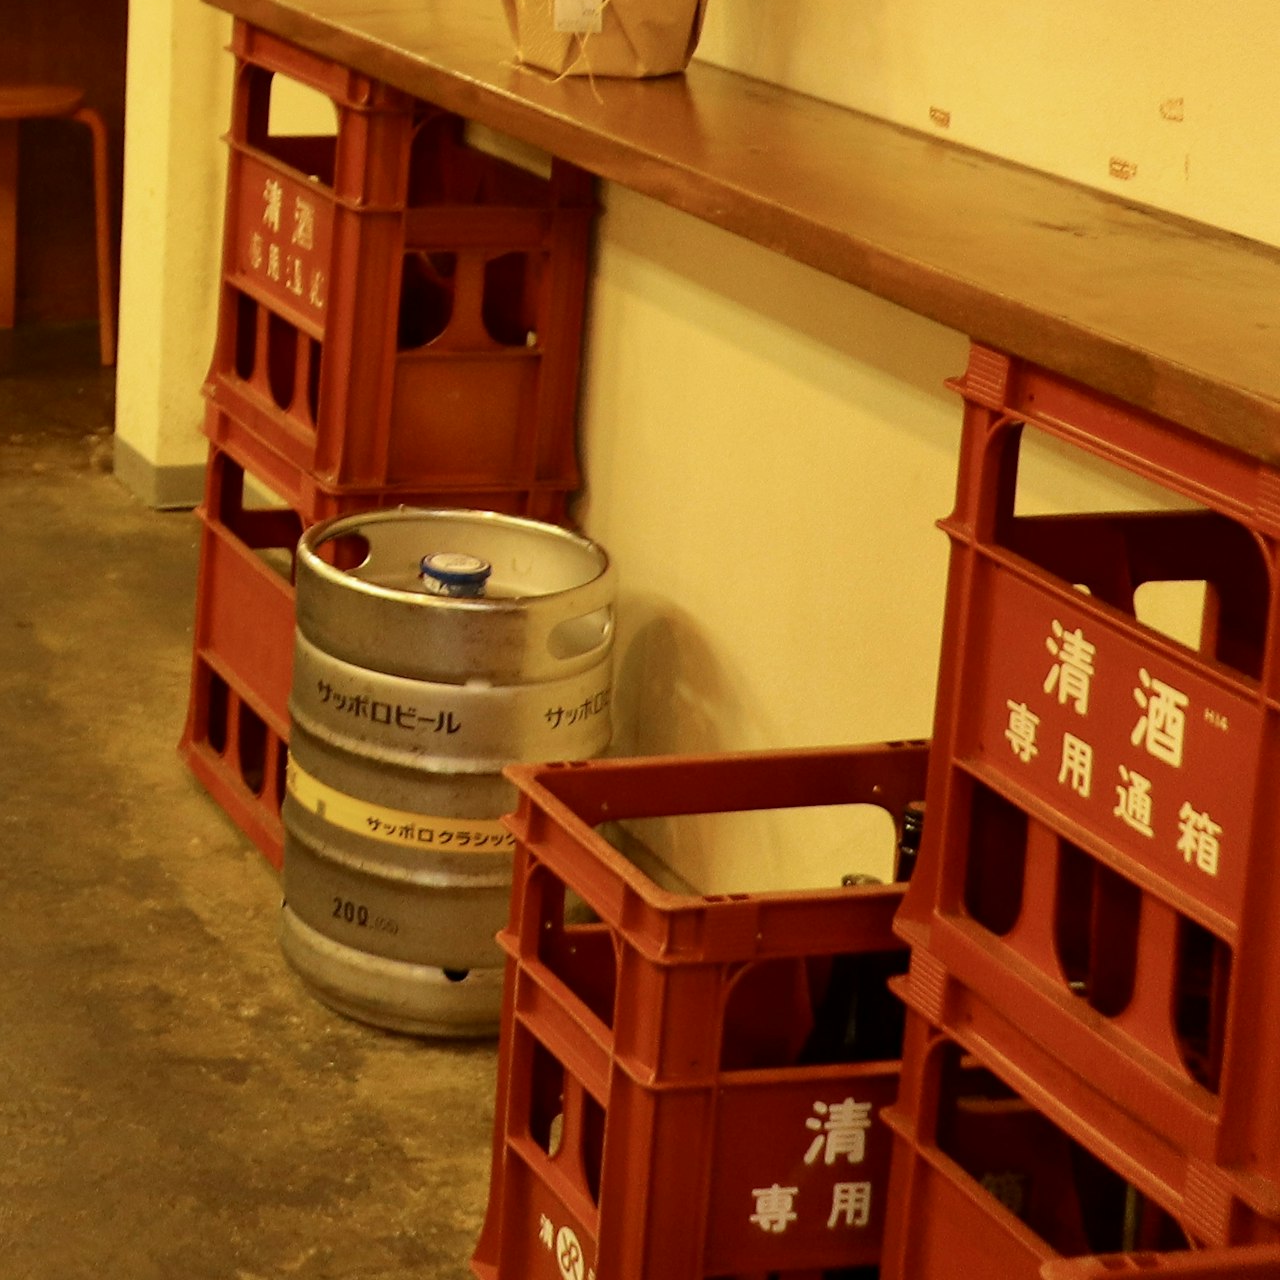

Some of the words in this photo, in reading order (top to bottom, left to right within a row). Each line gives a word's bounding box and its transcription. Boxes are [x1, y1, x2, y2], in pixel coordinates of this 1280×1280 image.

[317, 682, 461, 735] サッポロビール
[1043, 619, 1190, 769] 清酒
[1004, 697, 1223, 876] 専用通箱
